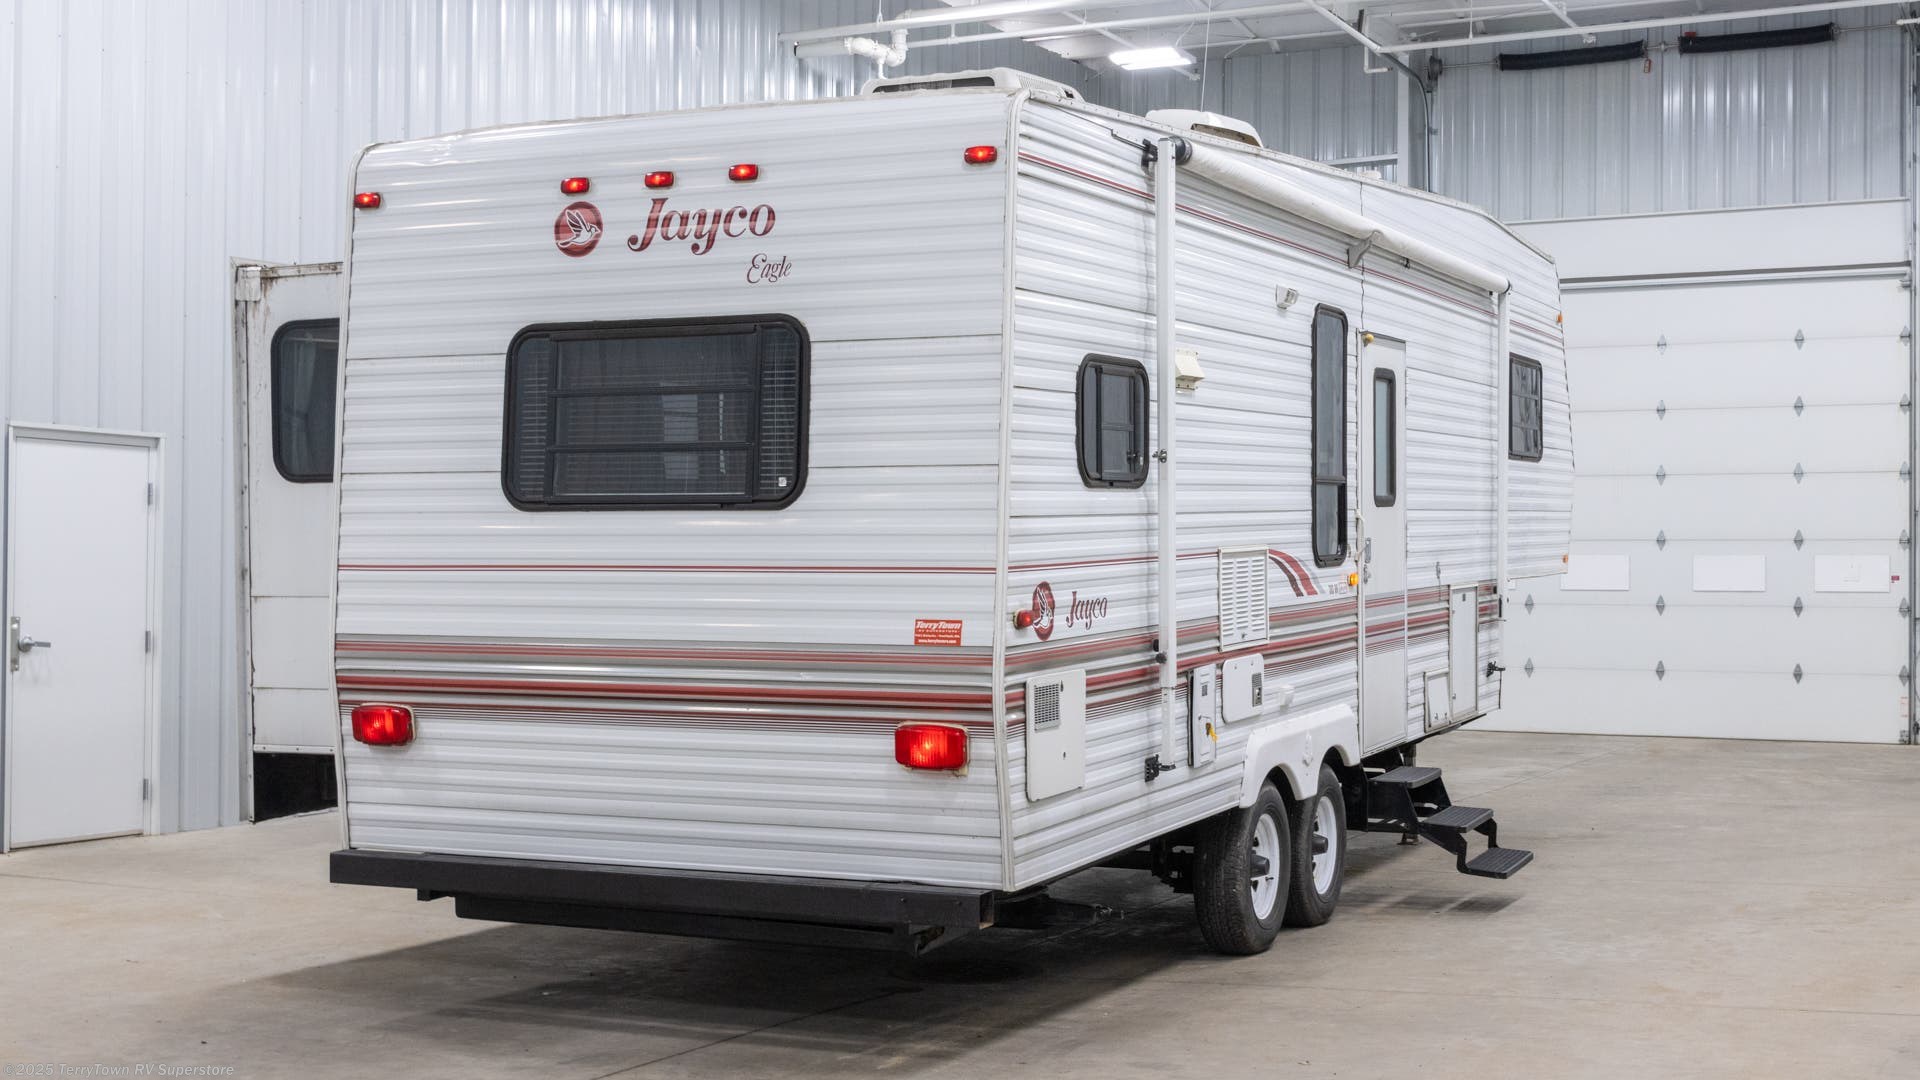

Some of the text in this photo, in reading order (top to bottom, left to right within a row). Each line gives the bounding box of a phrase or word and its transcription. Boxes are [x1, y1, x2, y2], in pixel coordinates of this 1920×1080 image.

[627, 197, 776, 256] Jayco
[746, 252, 792, 284] Eagle
[1065, 590, 1108, 630] Jayco
